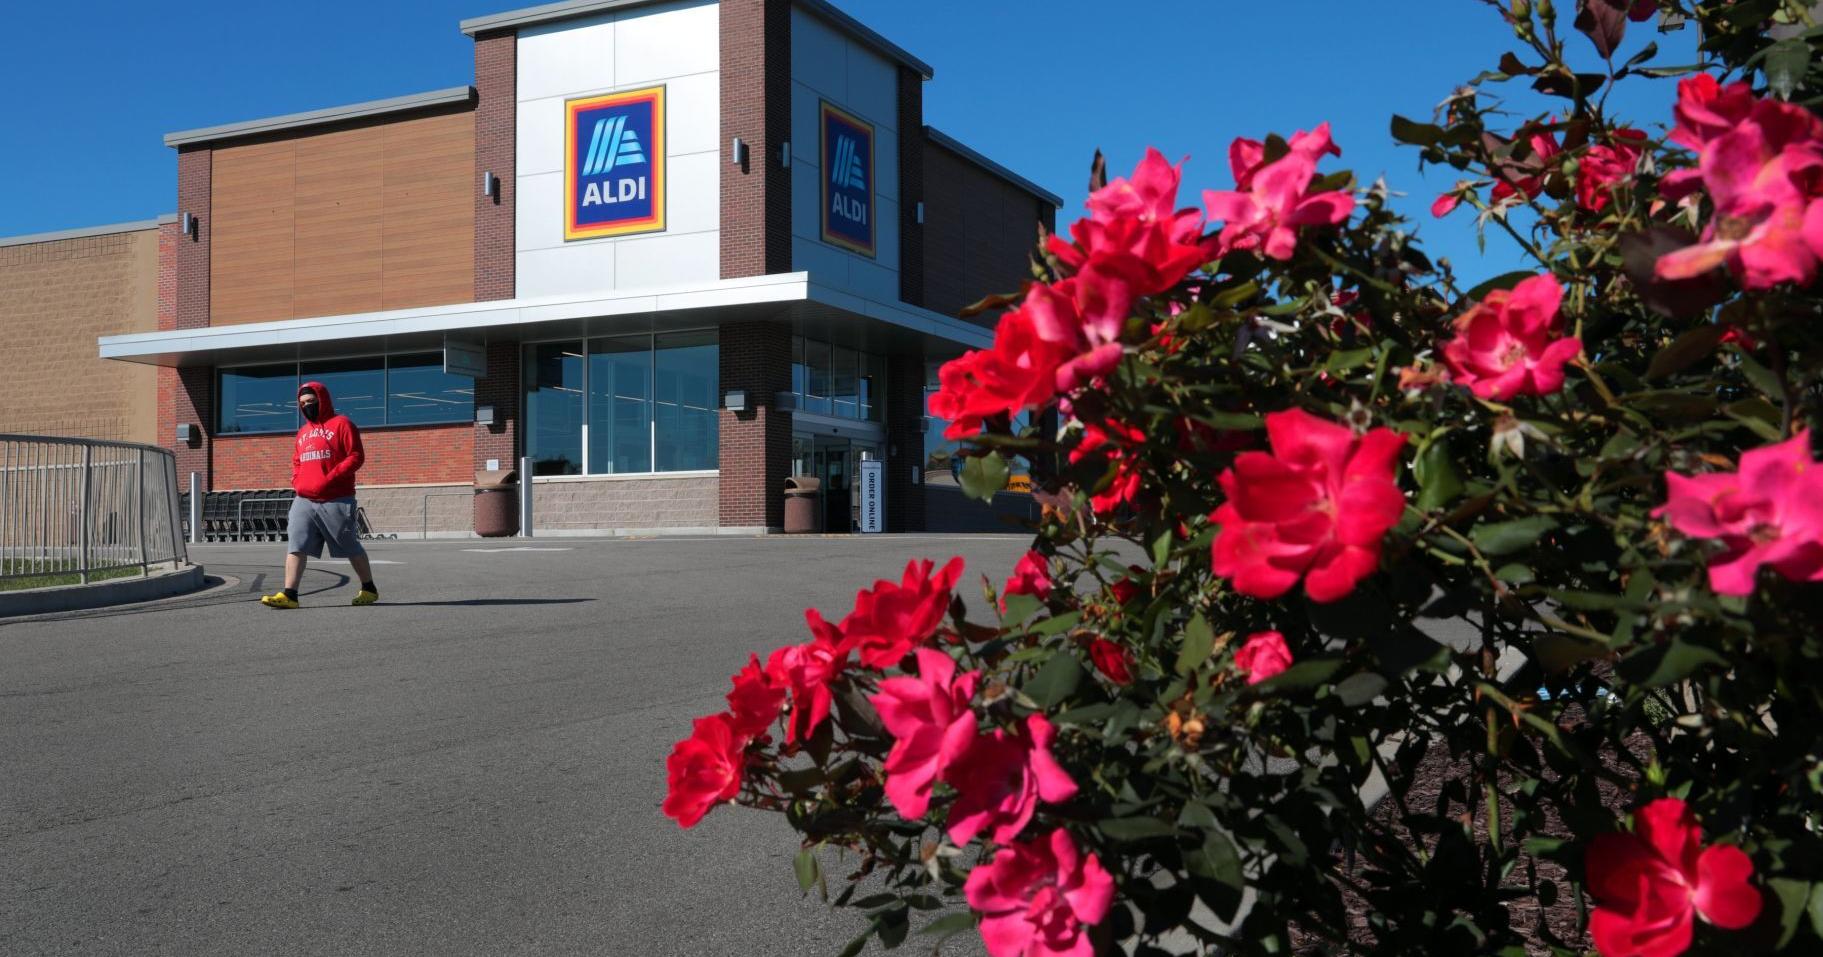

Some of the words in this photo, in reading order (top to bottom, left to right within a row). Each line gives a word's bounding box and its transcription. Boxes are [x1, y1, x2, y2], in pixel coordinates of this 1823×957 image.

[582, 176, 646, 207] ALDI
[832, 191, 867, 226] ALDI
[868, 501, 876, 532] ONLINE
